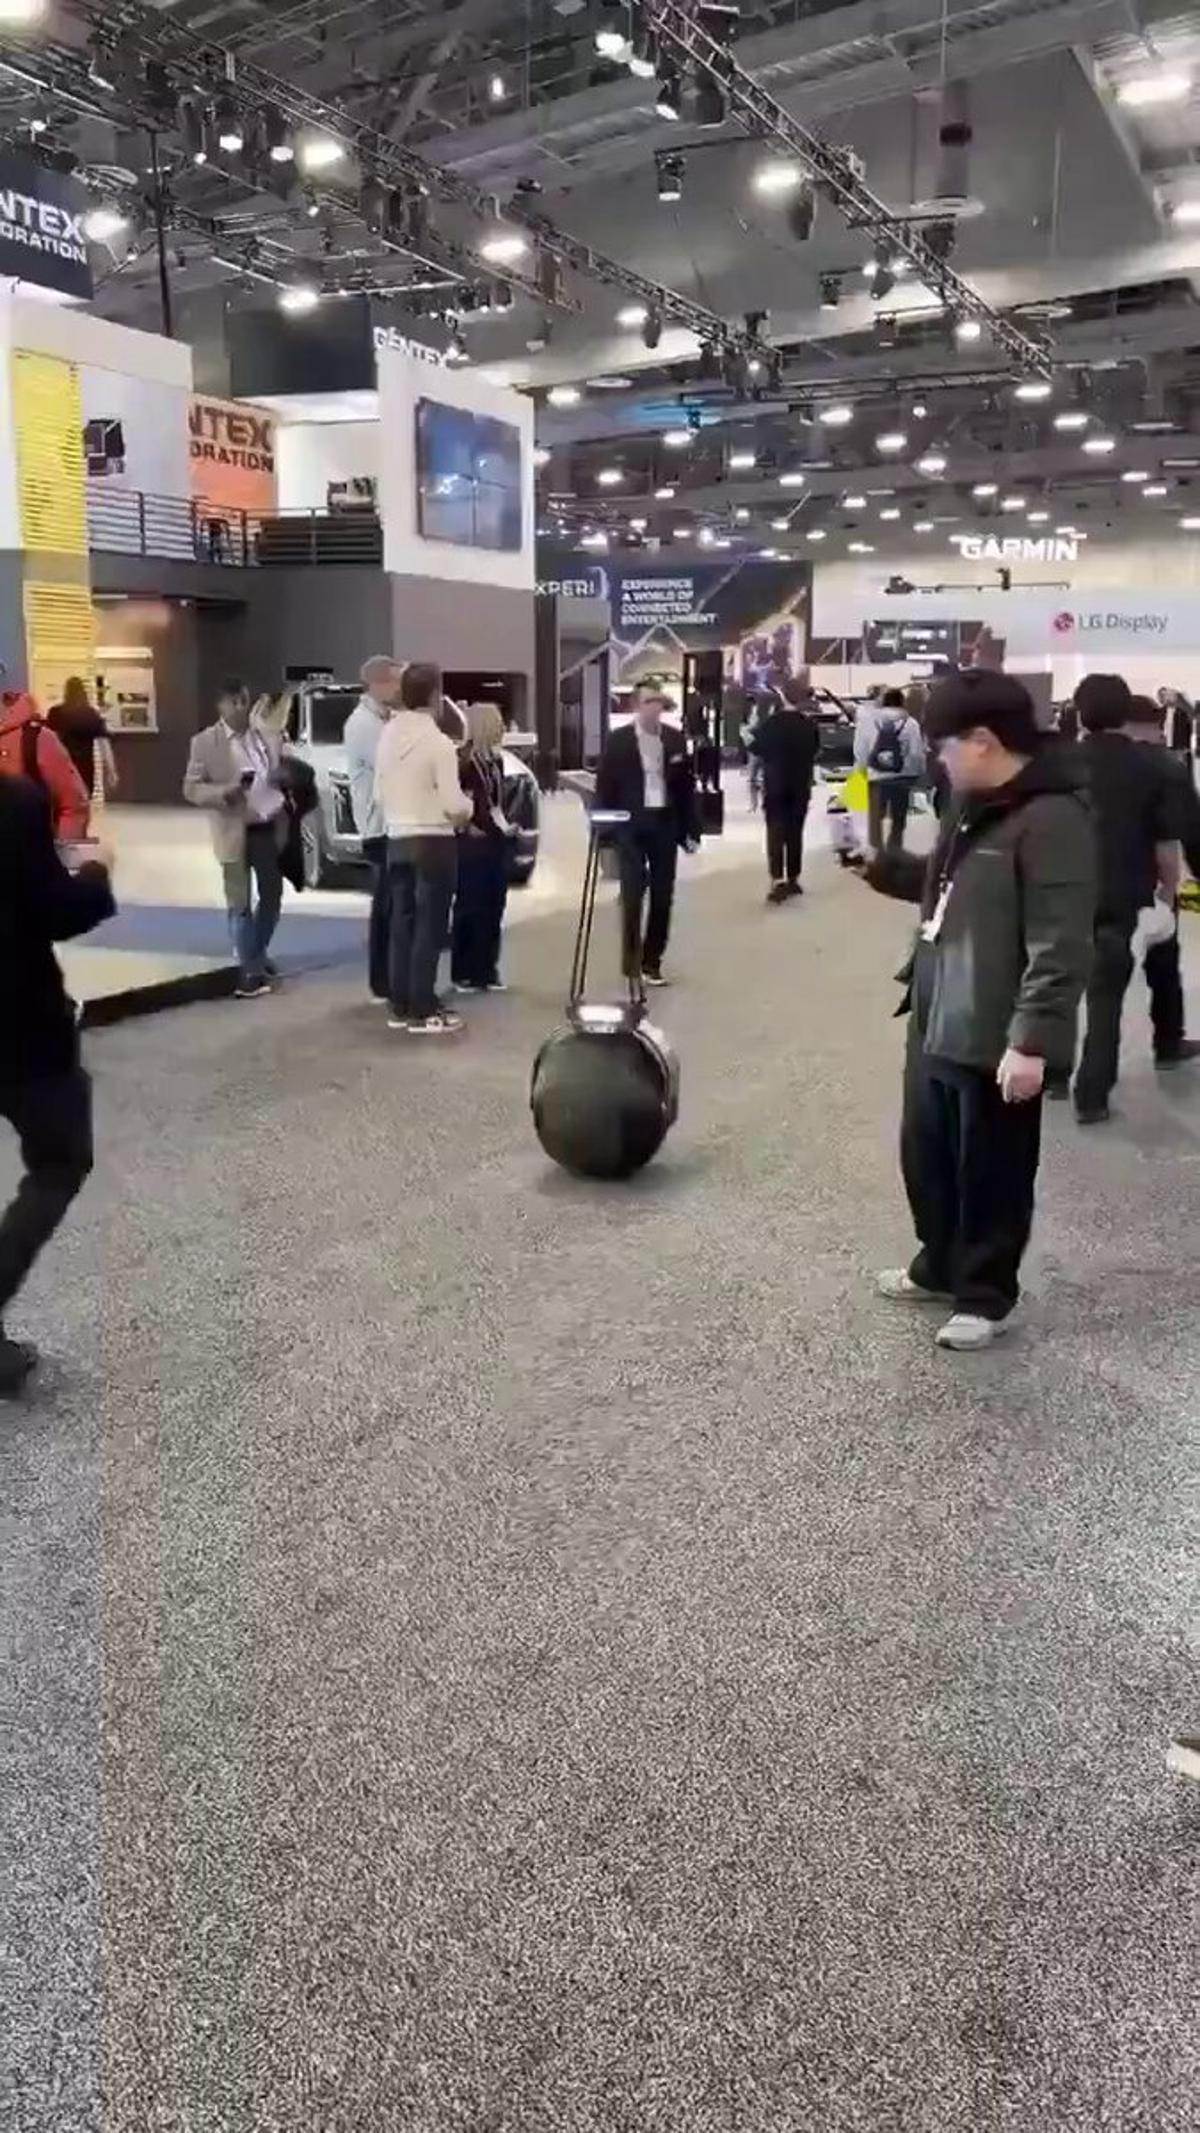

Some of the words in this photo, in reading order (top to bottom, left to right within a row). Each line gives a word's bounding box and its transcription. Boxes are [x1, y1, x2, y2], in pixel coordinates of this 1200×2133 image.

[960, 537, 1078, 561] GARMIN
[1079, 613, 1103, 630] LG
[1106, 613, 1169, 633] Display
